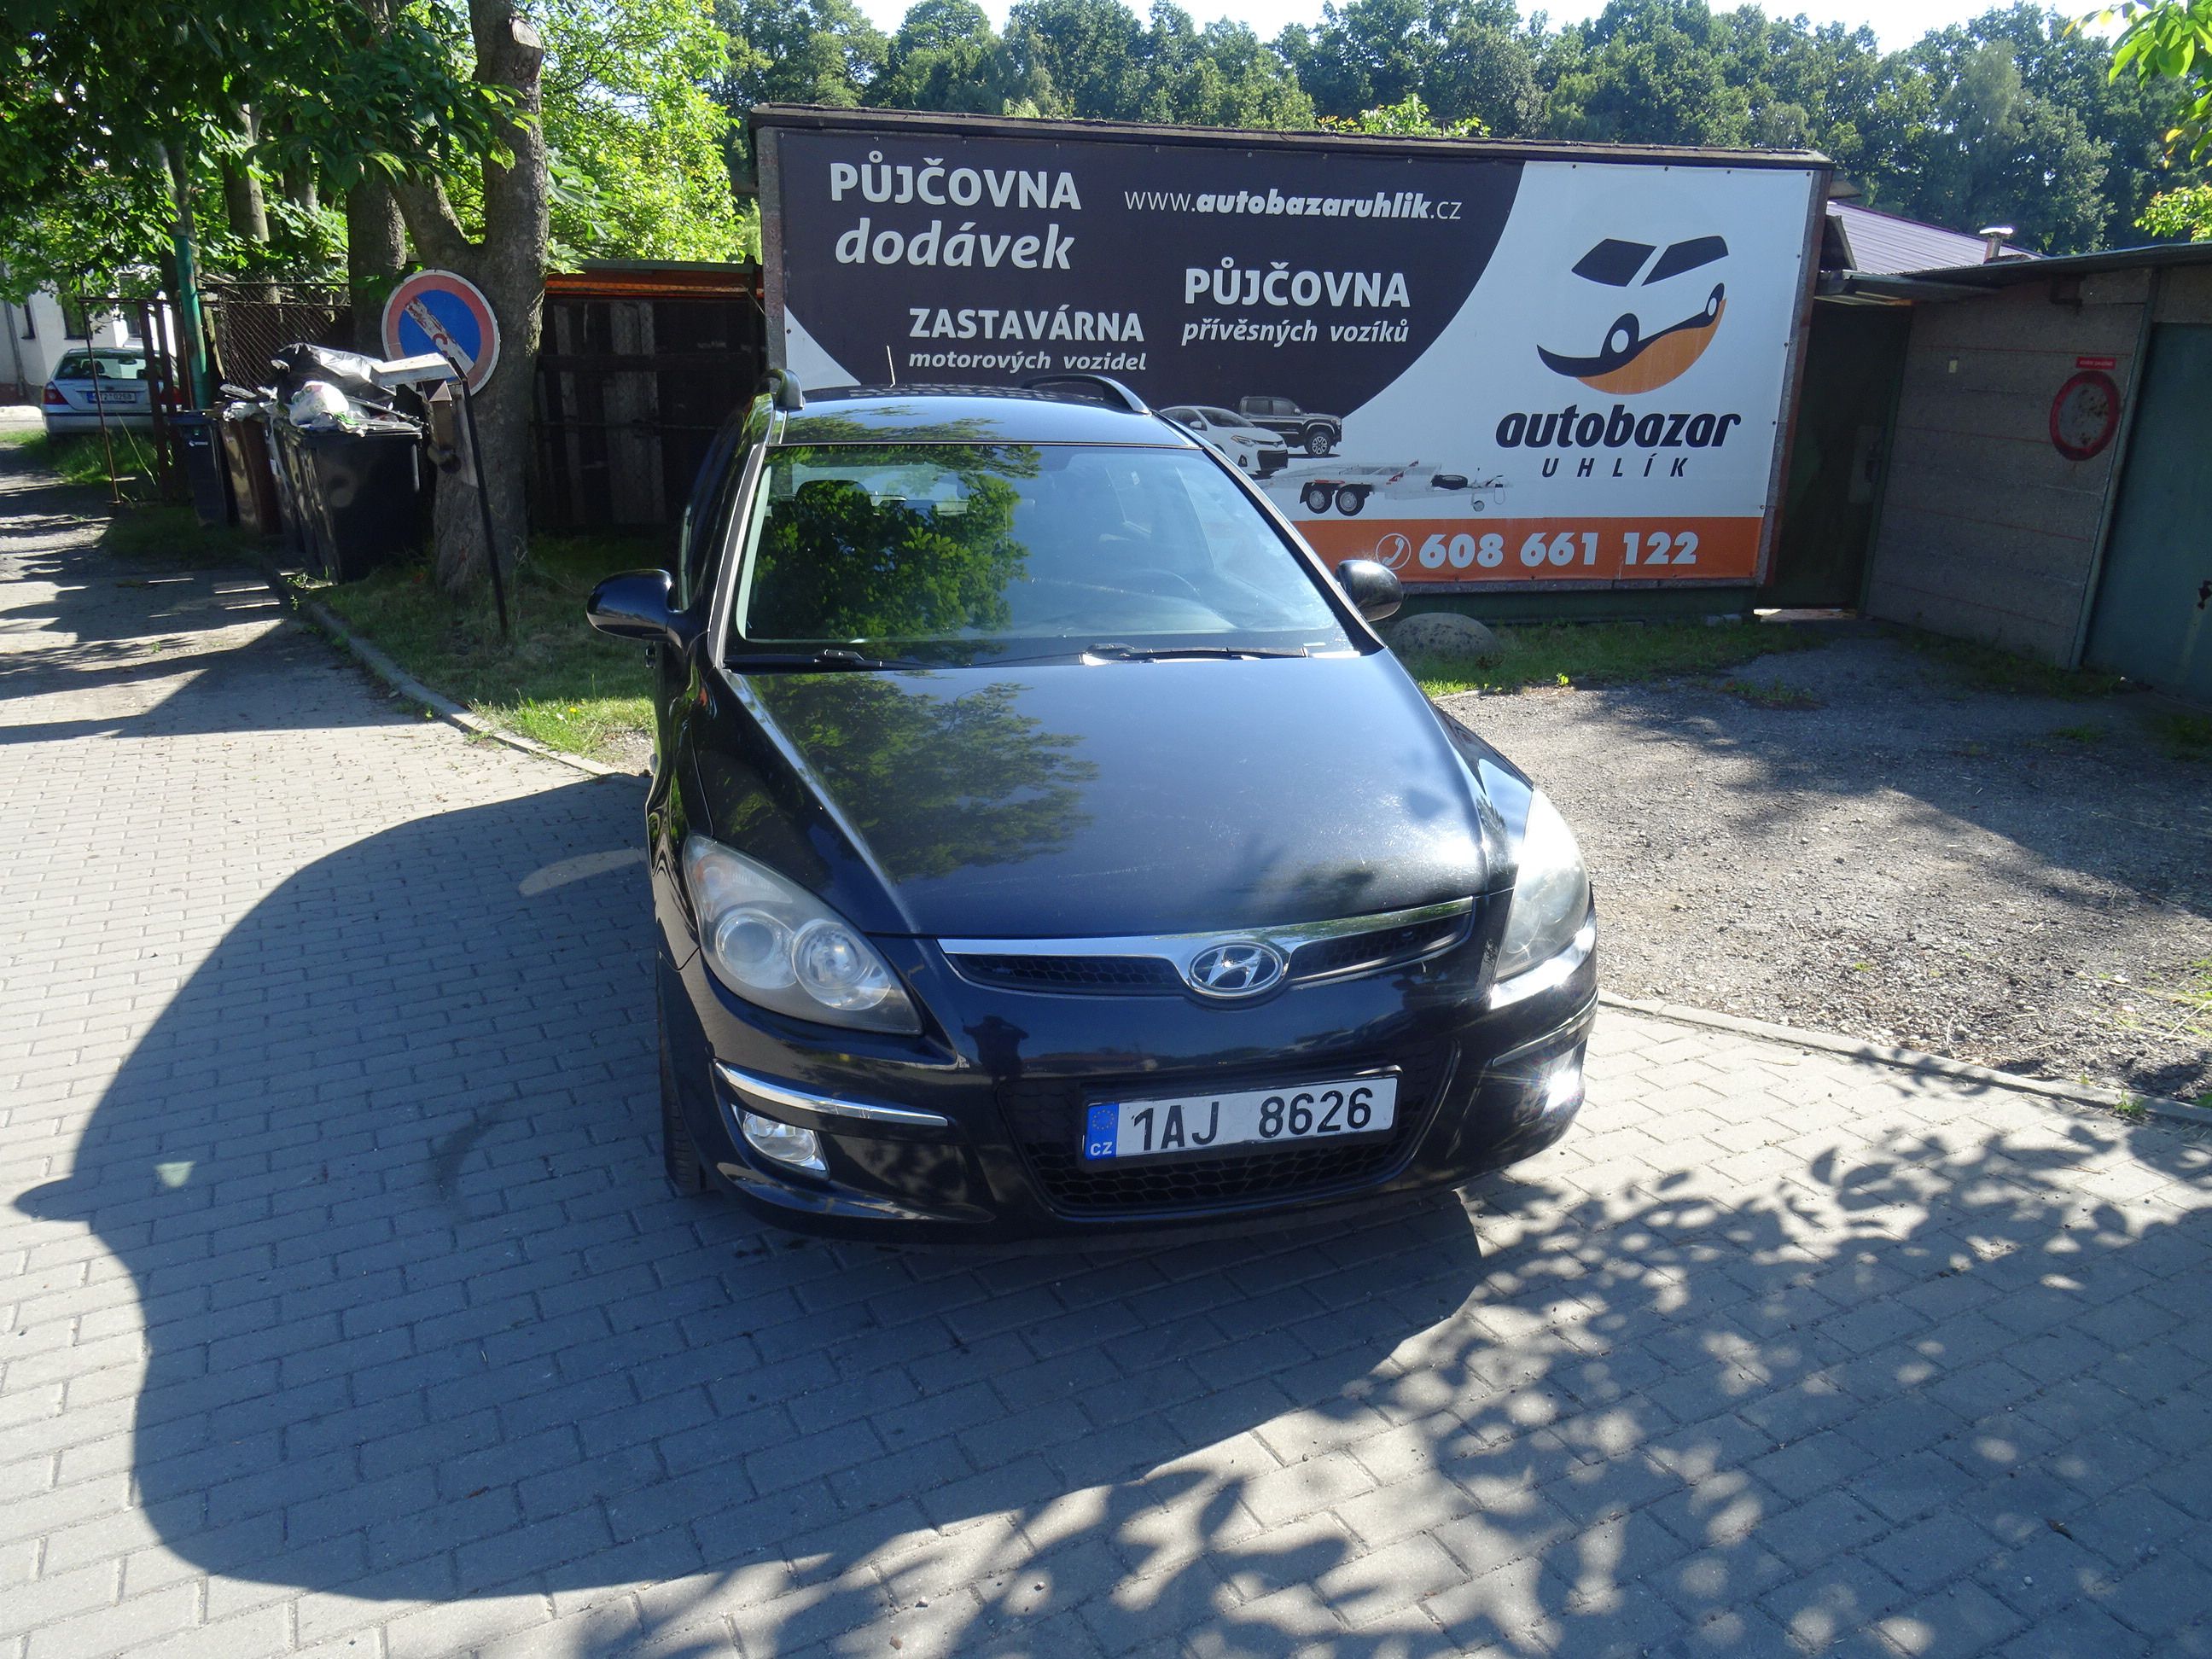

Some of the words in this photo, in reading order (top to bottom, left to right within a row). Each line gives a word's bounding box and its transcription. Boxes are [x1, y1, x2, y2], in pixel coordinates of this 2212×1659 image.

[830, 149, 1082, 211] PŮJČOVNA
[1124, 189, 1462, 219] www.autobazaruhlik.cz
[835, 218, 1075, 270] dodávek
[1185, 256, 1411, 308] PŮJČOVNA
[909, 305, 1144, 342] ZASTAVÁRNA
[1181, 317, 1318, 347] přívěsných
[1330, 318, 1409, 342] vozíků
[909, 351, 1051, 373] motorových
[1063, 352, 1146, 370] vozidel
[1495, 404, 1742, 449] autobazar
[1541, 452, 1689, 478] UHLÍK
[1418, 533, 1505, 569] 608
[1520, 532, 1599, 568] 661
[1623, 532, 1700, 566] 122
[1131, 1100, 1220, 1151] 1AJ
[1258, 1086, 1374, 1139] 8626
[1090, 1141, 1114, 1157] CZ
